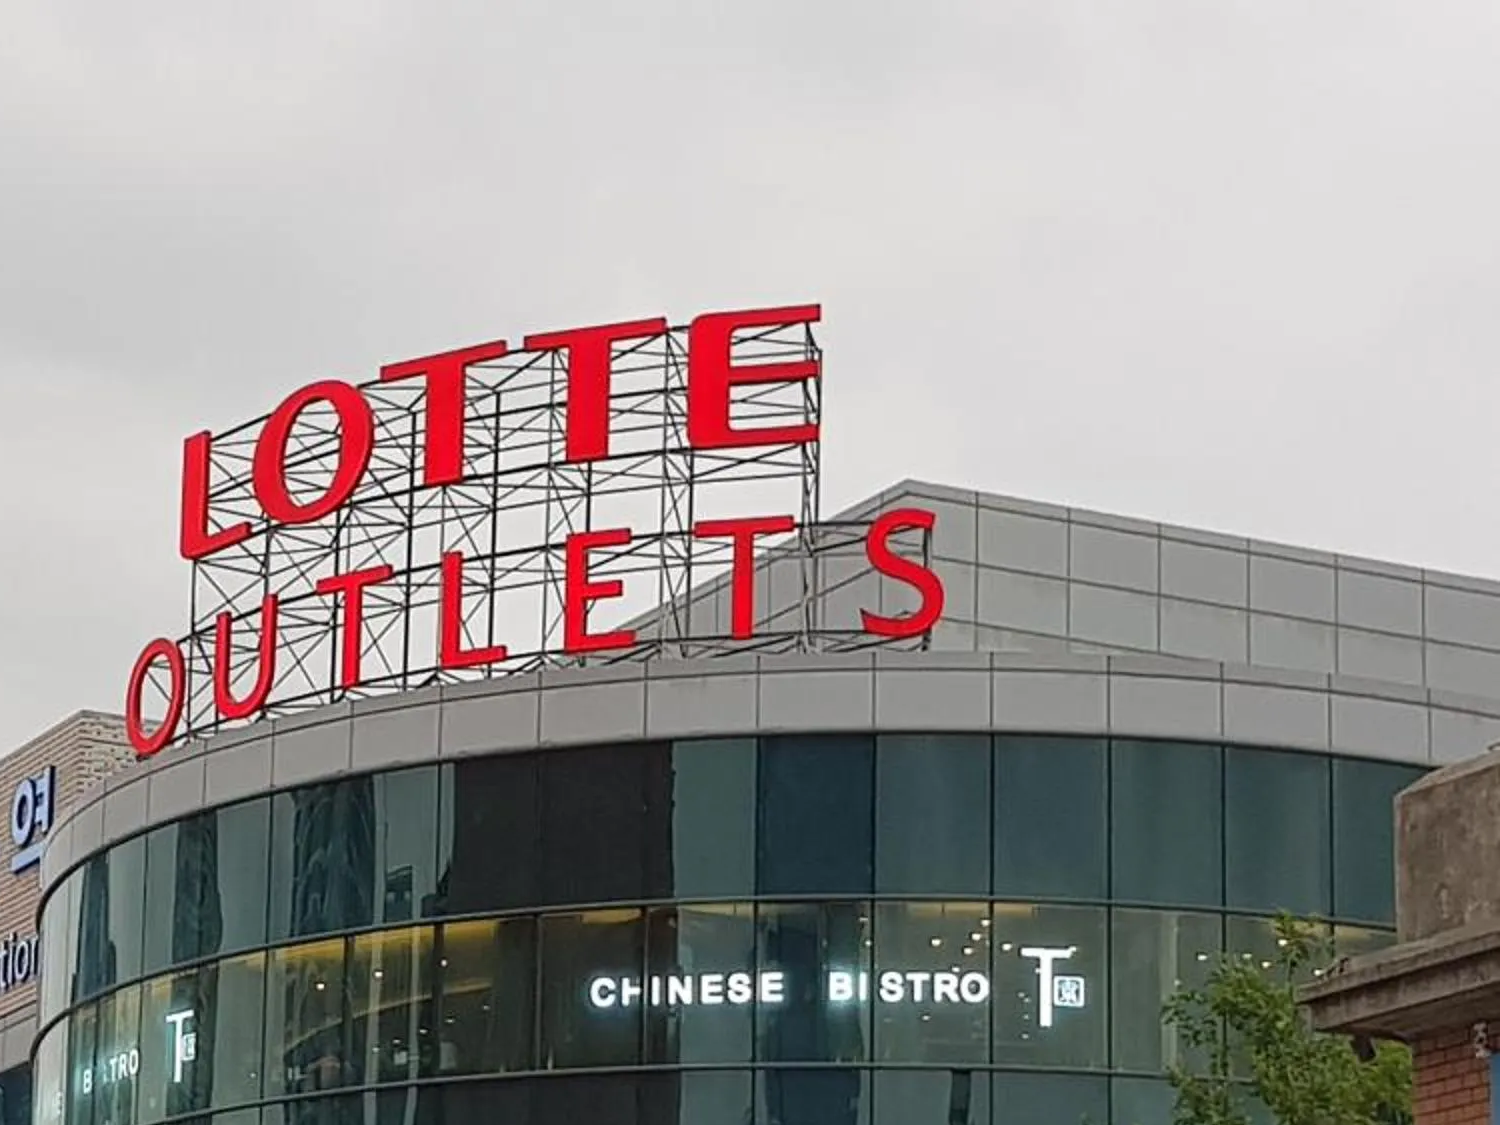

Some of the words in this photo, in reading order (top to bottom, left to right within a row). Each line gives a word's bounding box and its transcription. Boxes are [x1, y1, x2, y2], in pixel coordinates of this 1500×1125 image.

[180, 304, 822, 560] LOTTE
[126, 508, 946, 757] OUTLETS
[590, 971, 784, 1007] CHINESE
[828, 971, 990, 1003] BISTRO
[82, 1049, 140, 1095] BTRO
